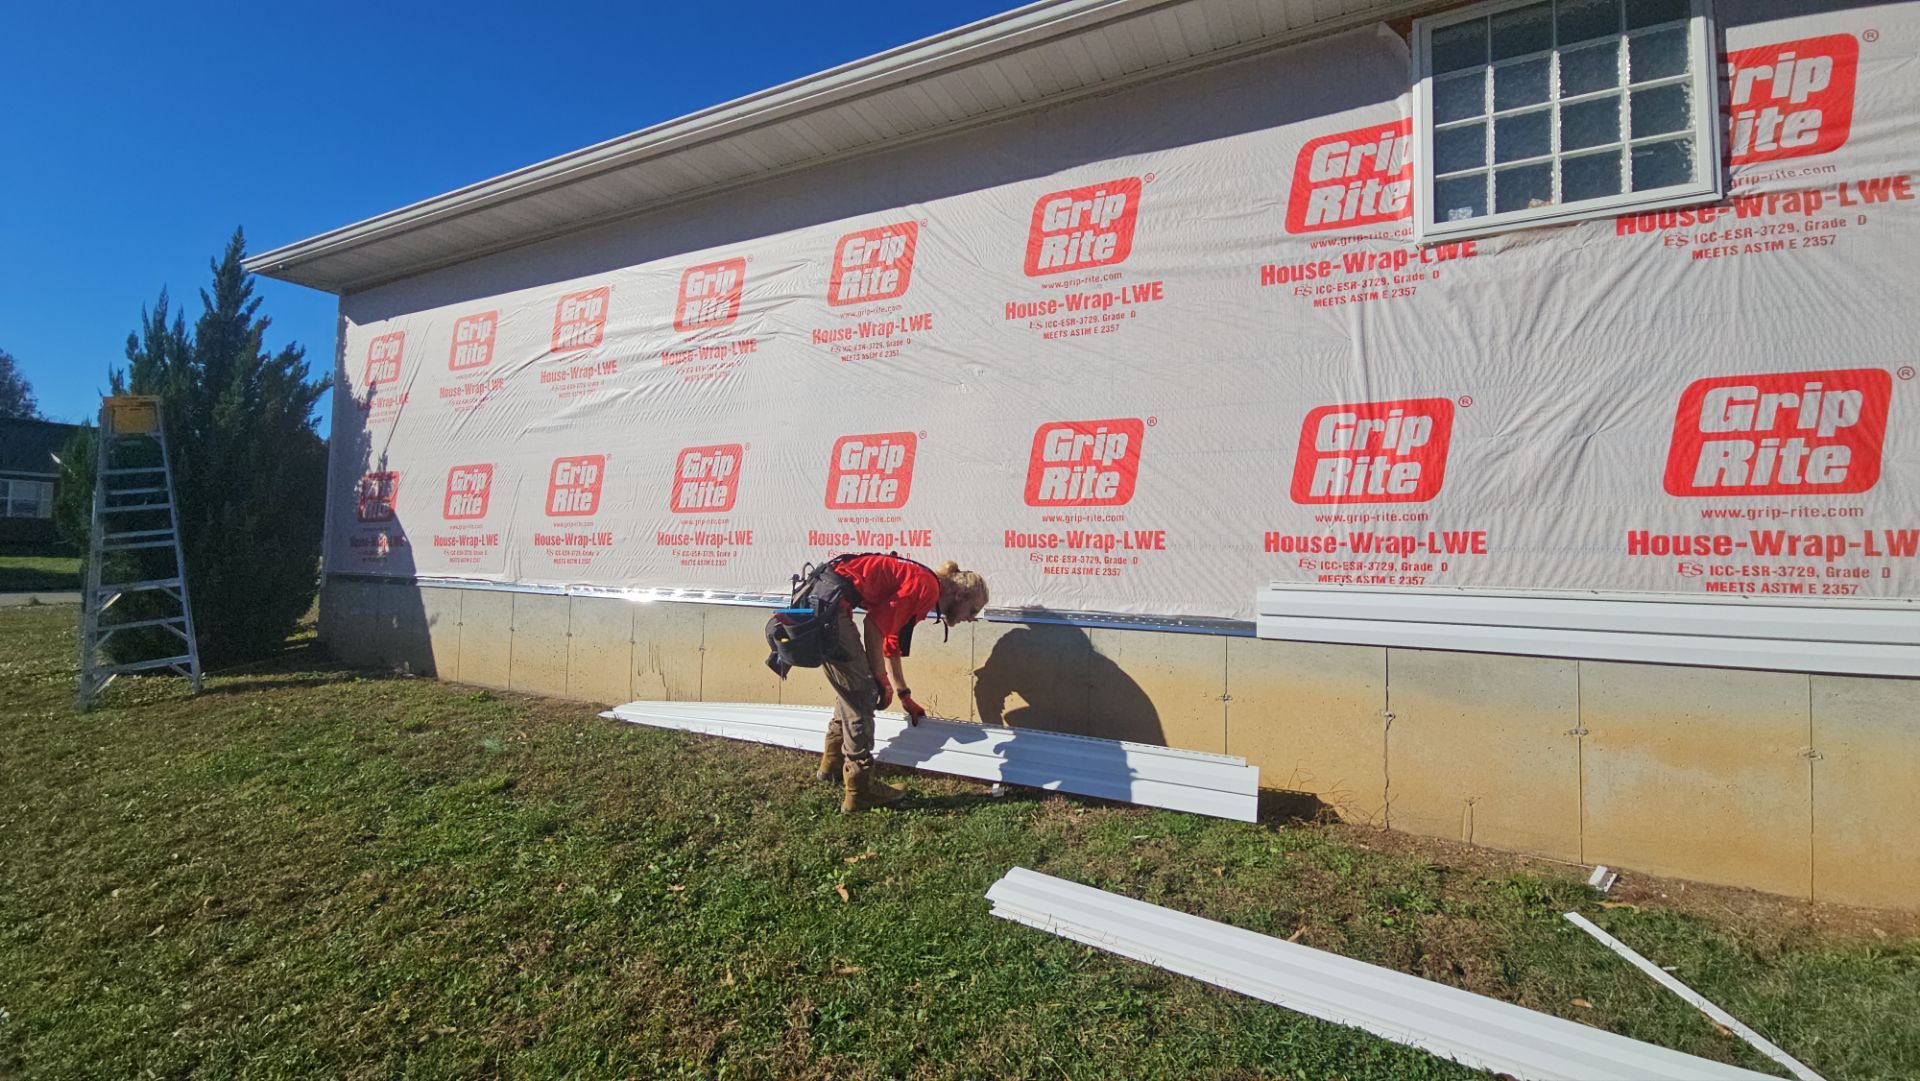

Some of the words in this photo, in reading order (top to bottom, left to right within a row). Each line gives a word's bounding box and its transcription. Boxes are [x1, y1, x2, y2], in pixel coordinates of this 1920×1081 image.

[1728, 51, 1833, 104] rip
[1729, 106, 1822, 157] ite
[1042, 190, 1126, 232] Grip
[1304, 178, 1411, 226] Rite
[1805, 218, 1846, 231] Grade
[1858, 215, 1867, 226] D
[841, 232, 906, 267] Grip
[1038, 230, 1117, 269] Rite
[1310, 228, 1413, 249] www.grip-rite.co
[1692, 246, 1738, 260] MEETS
[1744, 240, 1784, 254] ASTM
[1789, 239, 1796, 249] E
[1803, 236, 1836, 248] 2357
[687, 266, 736, 297] Grip
[838, 266, 899, 300] Rite
[1394, 273, 1424, 284] Grade
[1433, 270, 1439, 279] D
[561, 294, 603, 323] Grip
[1006, 281, 1163, 320] House-Wrap-LWE
[1314, 296, 1346, 307] MEETS
[1350, 292, 1378, 303] ASTM
[1383, 289, 1388, 298] E
[1392, 287, 1417, 298] 2357
[812, 313, 932, 344] House-Wrap-LWE
[661, 338, 757, 367] House-Wrap-LWE
[540, 360, 617, 383] House-Wrap-LWE
[1700, 382, 1863, 437] Grip
[1315, 409, 1433, 455] Grip
[841, 440, 905, 474] Grip
[1043, 428, 1128, 466] Grip
[556, 460, 597, 488] Grip
[682, 451, 733, 481] Grip
[1309, 455, 1421, 497] Rite
[1692, 438, 1851, 487] Rite
[452, 468, 486, 493] Grip
[836, 474, 898, 504] Rite
[1038, 466, 1120, 500] Rite
[448, 494, 482, 514] Rite
[552, 488, 593, 512] Rite
[678, 481, 728, 508] Rite
[1042, 514, 1124, 524] www.grip-rite.com
[1315, 512, 1429, 524] www.grip-rite.com
[1701, 506, 1864, 520] www.grip-rite.com
[434, 534, 498, 548] House-Wrap-LWE
[535, 532, 612, 548] House-Wrap-LWE
[657, 530, 753, 548] House-Wrap-LWE
[808, 530, 932, 549] House-Wrap-LWE
[1005, 530, 1166, 553] House-Wrap-LWE
[1265, 531, 1487, 558] House-Wrap-LWE
[1628, 530, 1920, 562] House-Wrap-LW
[1105, 556, 1127, 564] Grade
[1402, 561, 1432, 572] Grade
[1441, 562, 1448, 571] D
[1710, 566, 1819, 579] ICC-ESR-3729,
[1826, 567, 1869, 578] Grade
[1882, 567, 1890, 578] D
[1318, 575, 1352, 583] MEETS
[1356, 575, 1386, 584] ASTM
[1390, 576, 1395, 585] E
[1399, 576, 1424, 585] 2357
[1706, 582, 1755, 593] MEETS
[1761, 583, 1802, 593] ASTM
[1809, 583, 1816, 594] E
[1822, 584, 1858, 595] 2357
